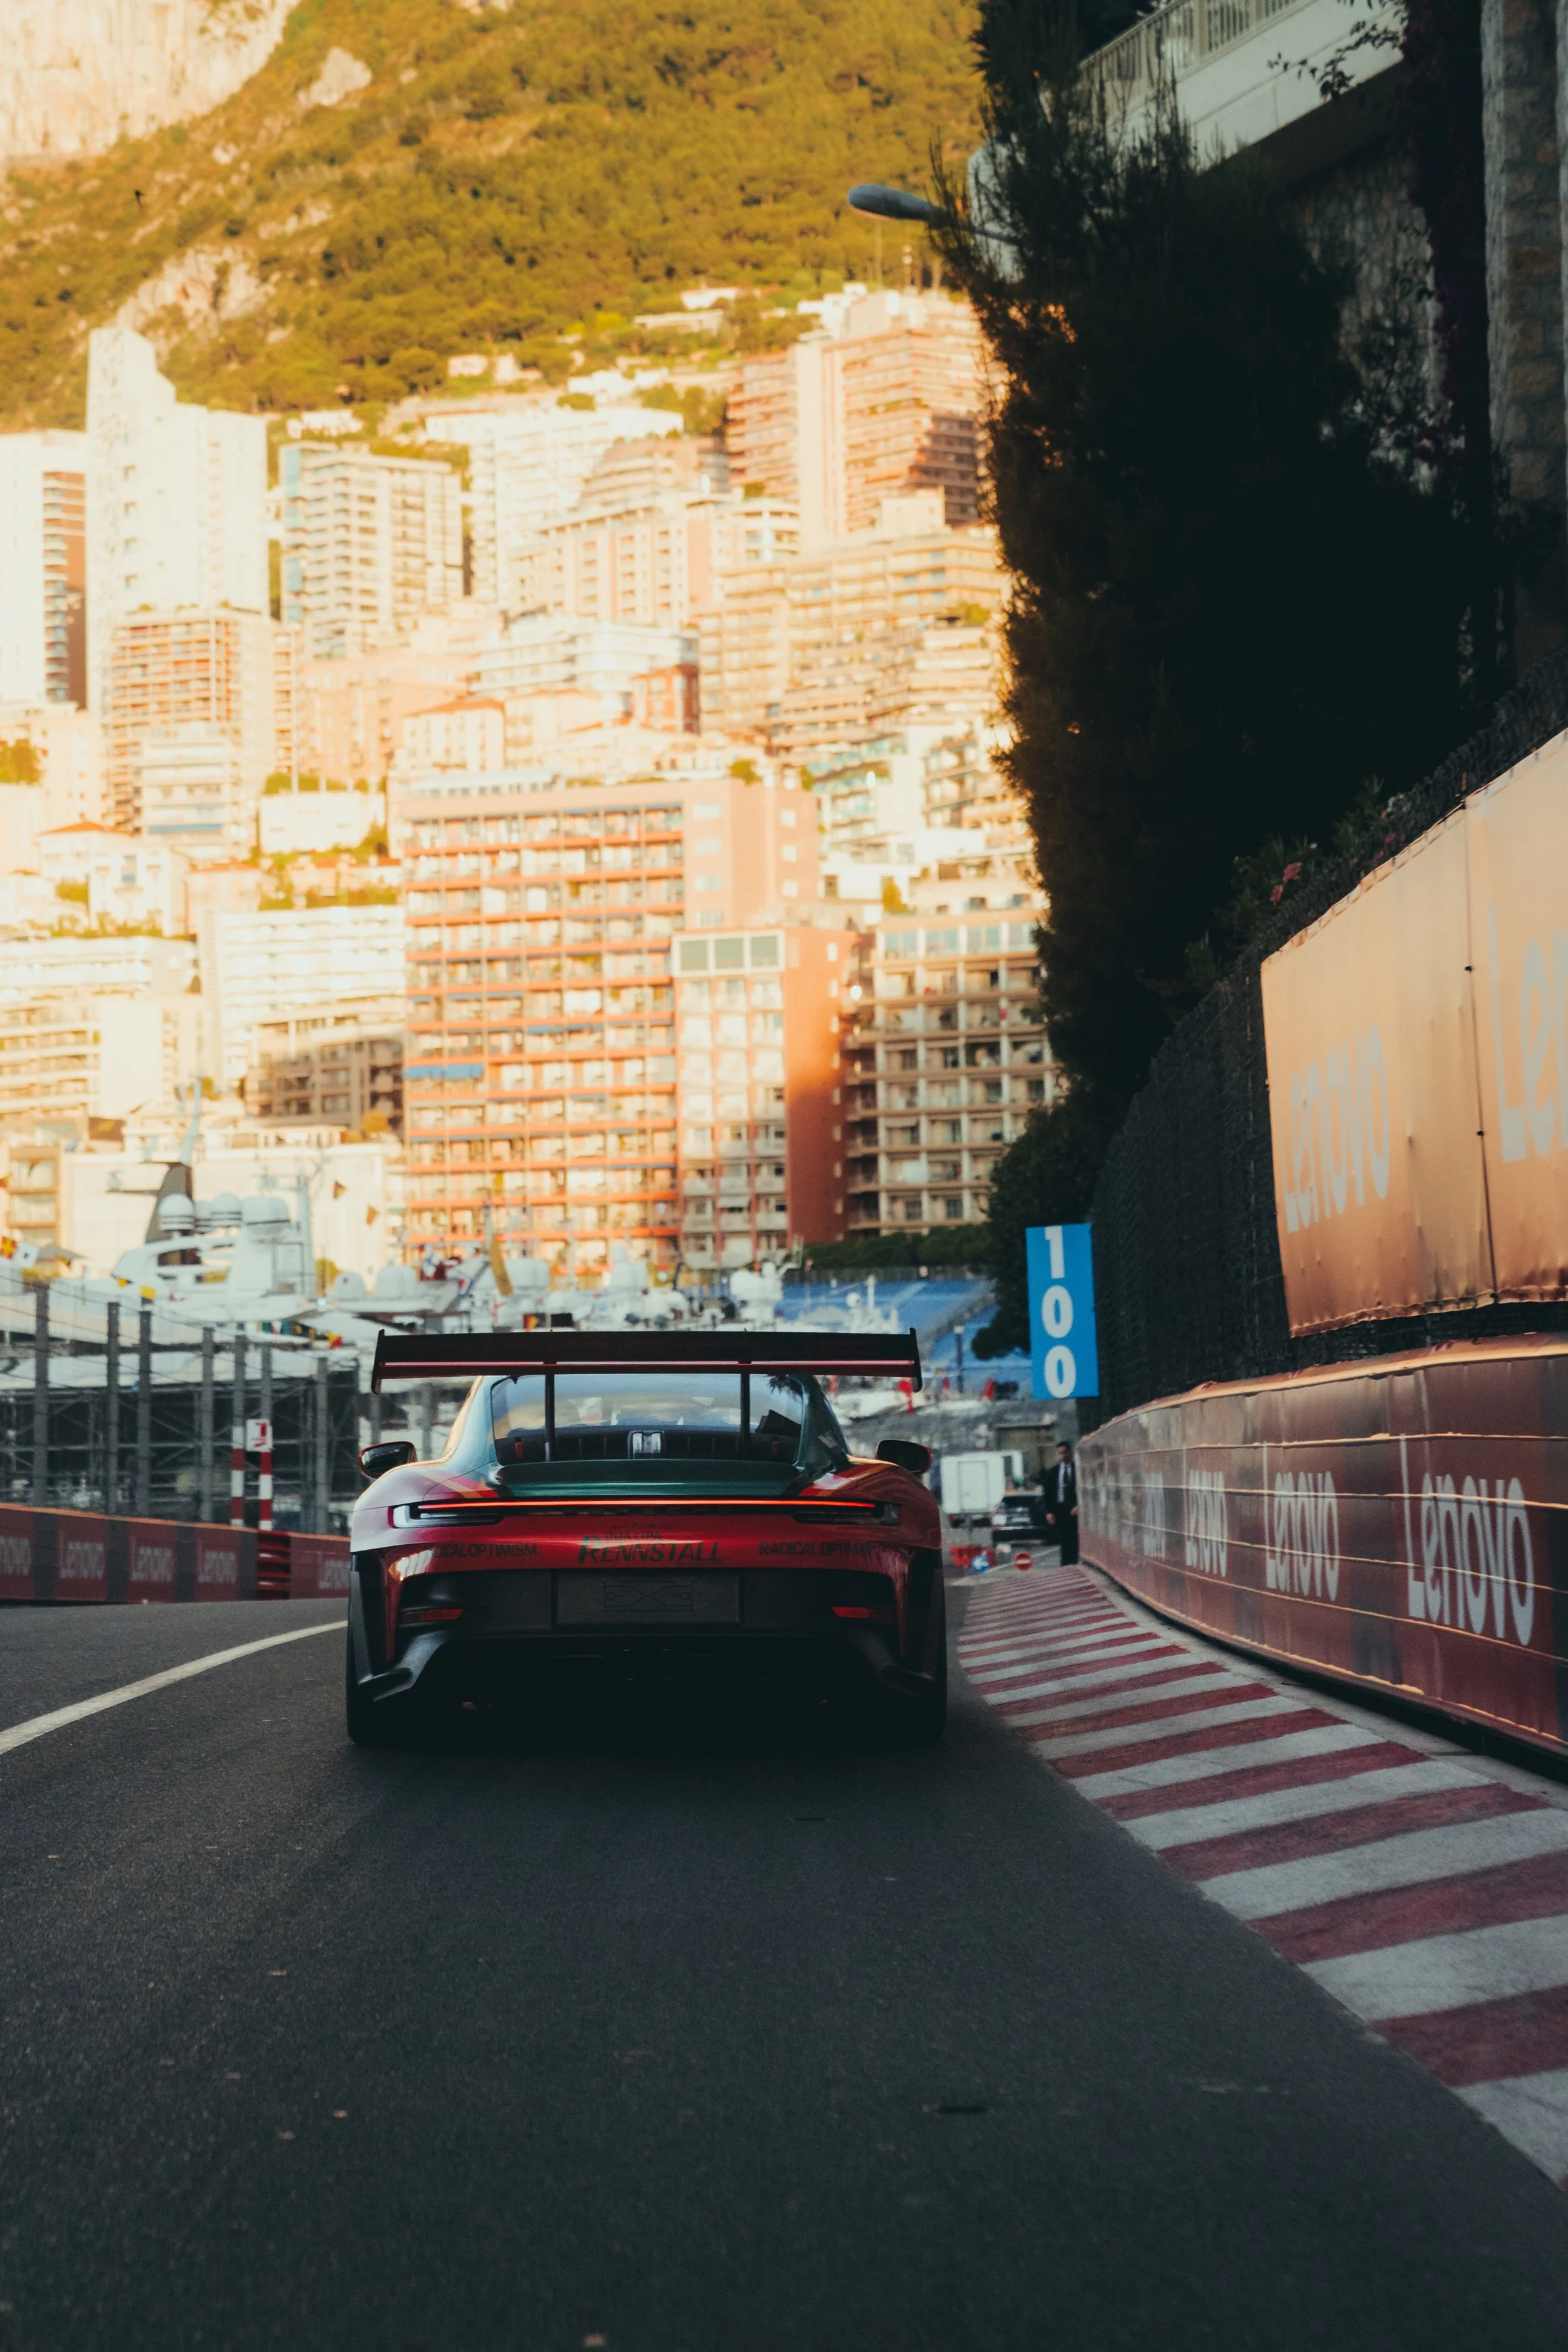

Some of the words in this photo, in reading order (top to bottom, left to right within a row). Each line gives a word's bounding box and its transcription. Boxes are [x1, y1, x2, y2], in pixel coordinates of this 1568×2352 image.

[1273, 1024, 1390, 1234] Lenovo
[1041, 1226, 1076, 1398] 100
[577, 1535, 723, 1564] RENNSTALL
[759, 1541, 817, 1555] RADICAL
[1183, 1448, 1227, 1577] Lenovo
[1263, 1441, 1340, 1601] Lenovo
[1400, 1433, 1535, 1646] Lenovo
